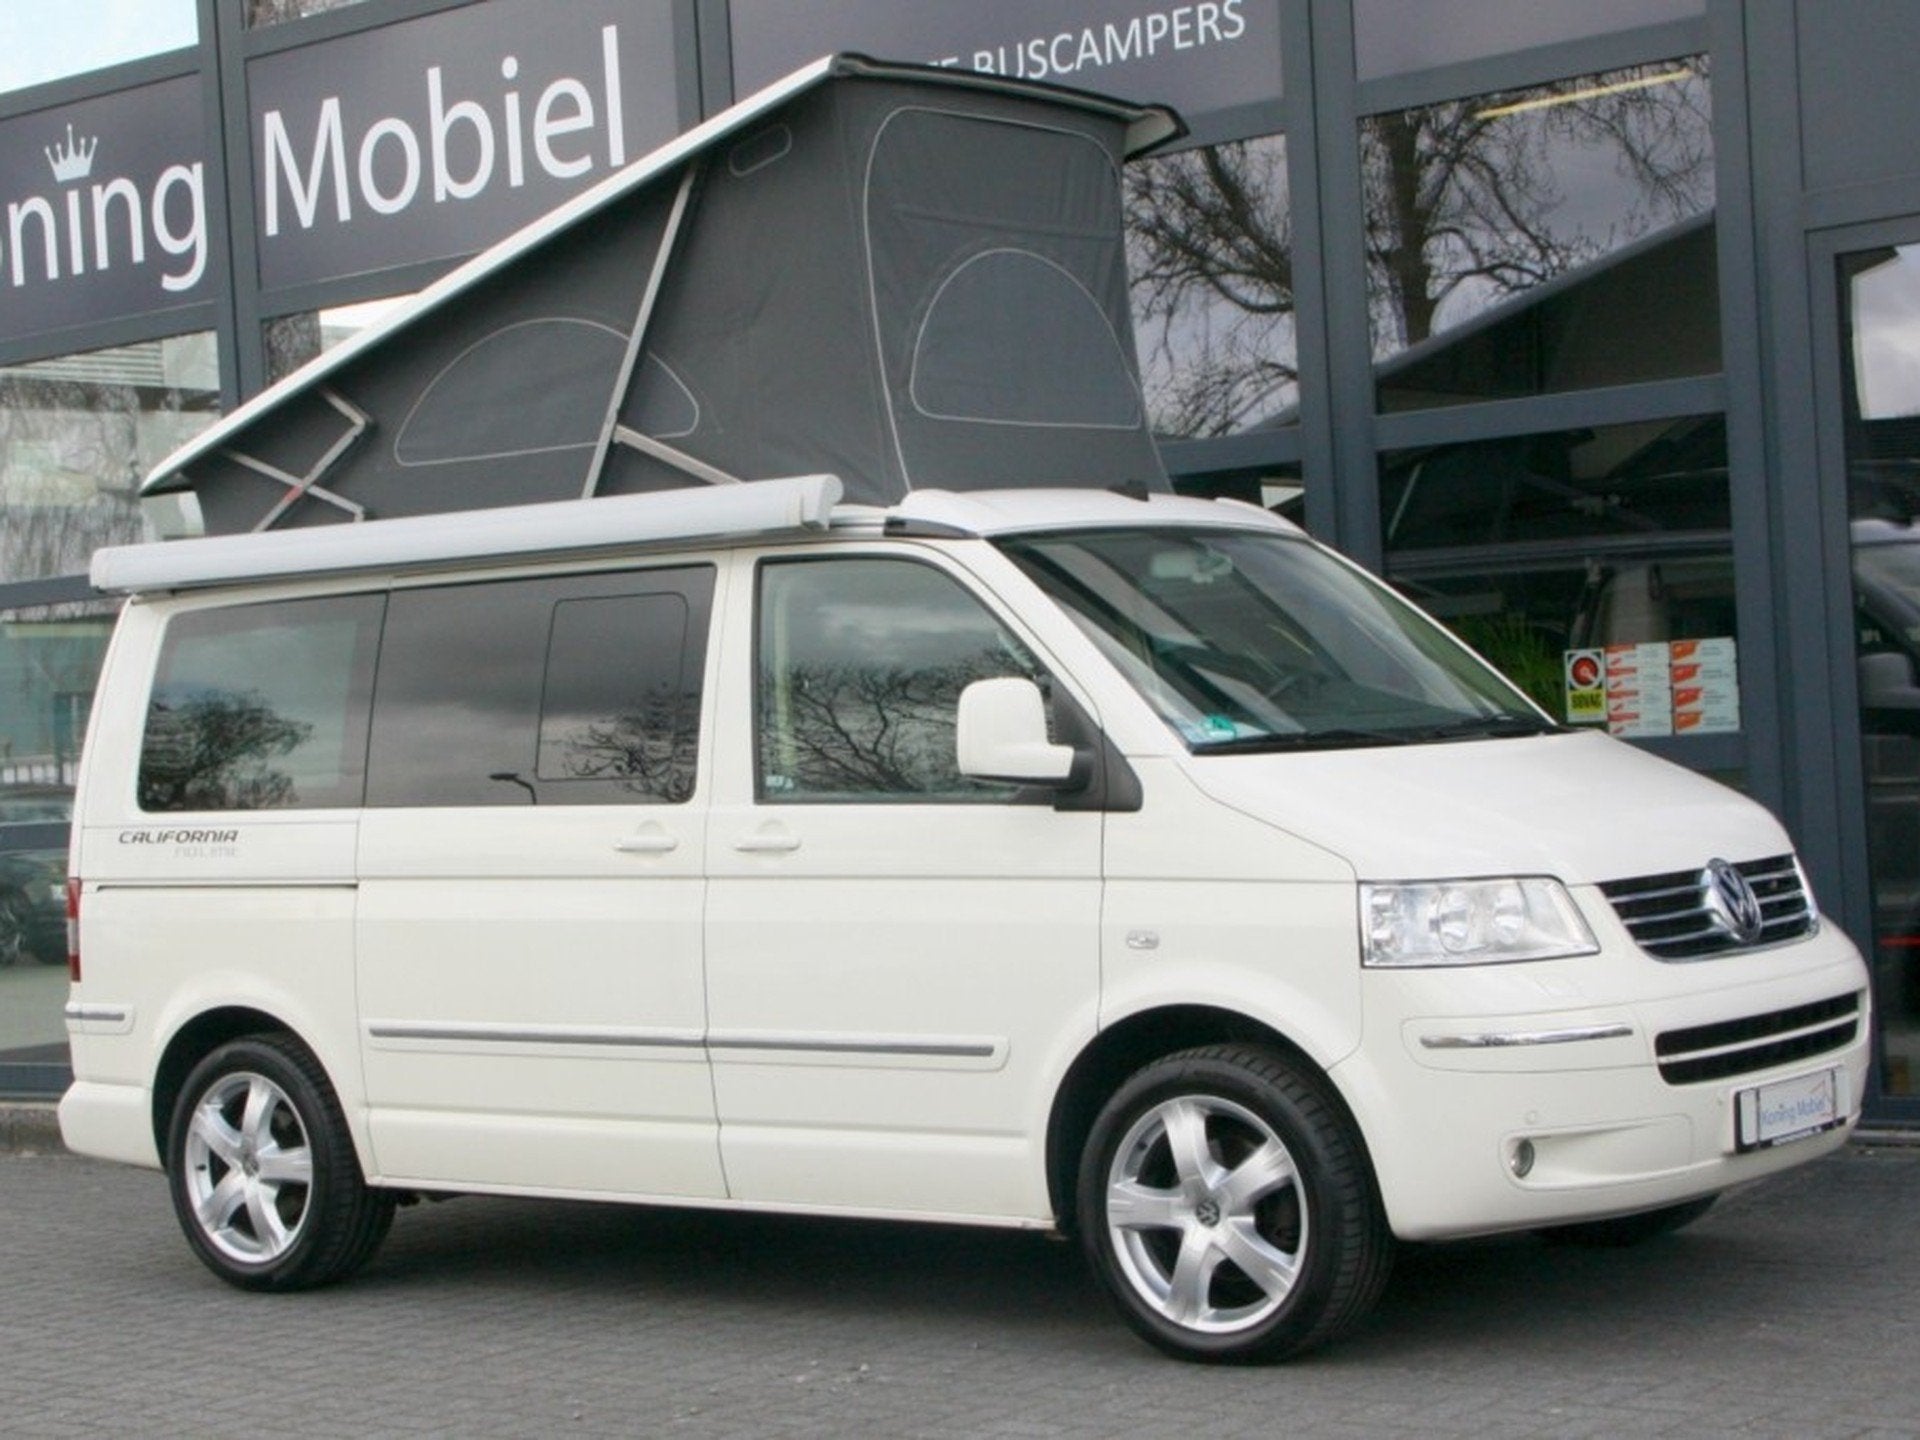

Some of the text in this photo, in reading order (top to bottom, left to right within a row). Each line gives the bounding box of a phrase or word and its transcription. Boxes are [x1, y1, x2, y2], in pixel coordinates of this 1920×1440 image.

[973, 0, 1246, 79] BUSCAMPERS
[0, 24, 626, 292] ning Mobiel
[118, 830, 239, 845] CALIFORNIA
